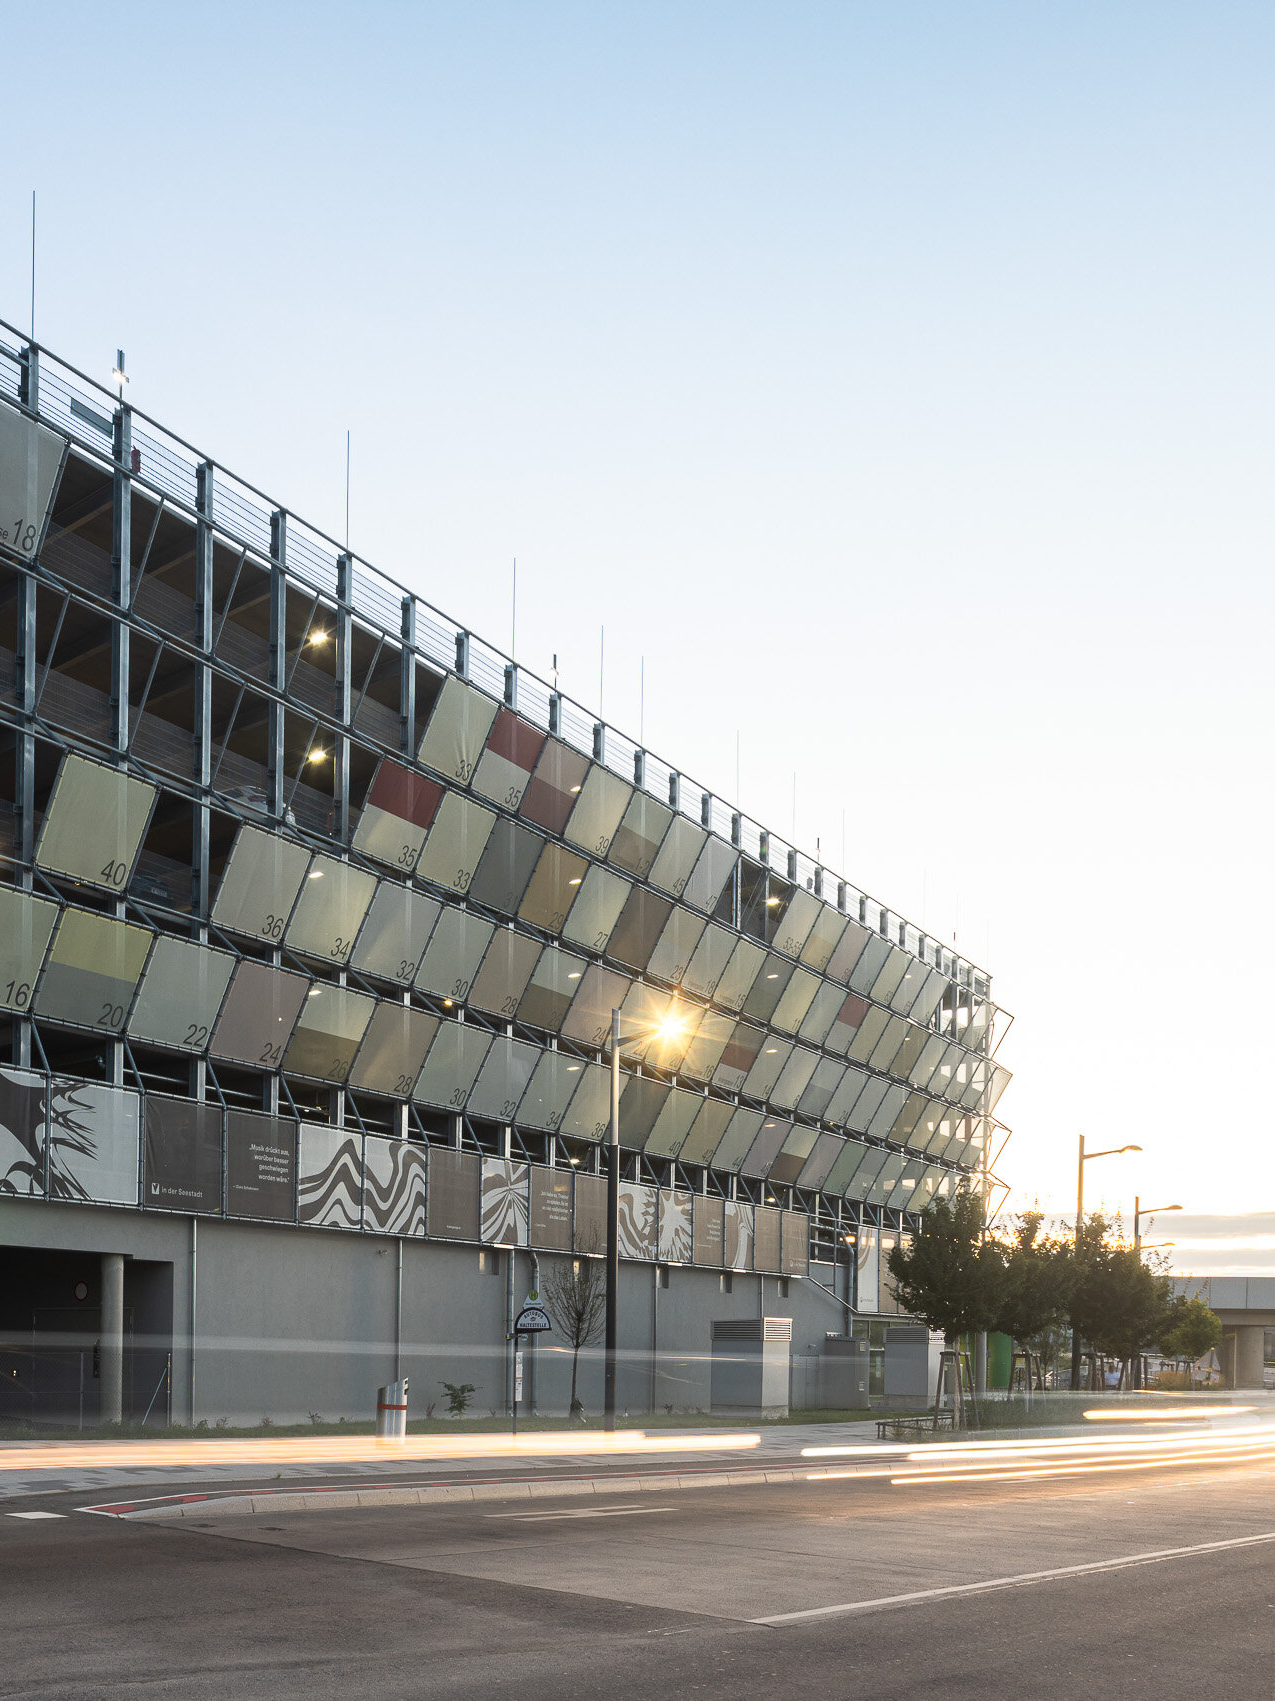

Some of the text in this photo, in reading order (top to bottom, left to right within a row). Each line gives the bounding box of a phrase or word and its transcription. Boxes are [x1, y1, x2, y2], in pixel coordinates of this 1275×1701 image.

[13, 518, 37, 552] 18
[455, 758, 472, 781] 33
[504, 787, 520, 807] 35
[595, 835, 609, 854] 39
[398, 845, 419, 866] 35
[100, 859, 127, 887] 40
[453, 869, 470, 890] 33
[261, 914, 285, 939] 36
[548, 911, 565, 930] 29
[330, 938, 351, 960] 34
[593, 931, 608, 949] 27
[396, 960, 415, 980] 32
[670, 964, 684, 981] 23
[5, 980, 31, 1008] 16
[451, 979, 468, 998] 30
[97, 1002, 124, 1028] 20
[500, 995, 517, 1015] 28
[182, 1022, 209, 1049] 22
[591, 1027, 606, 1043] 24
[259, 1042, 283, 1065] 24
[328, 1058, 349, 1081] 26
[393, 1075, 413, 1098] 28
[450, 1088, 467, 1107] 30
[499, 1100, 516, 1119] 32
[546, 1111, 563, 1129] 34
[590, 1121, 605, 1139] 36
[167, 1187, 177, 1195] der
[178, 1188, 203, 1198] Seestadt
